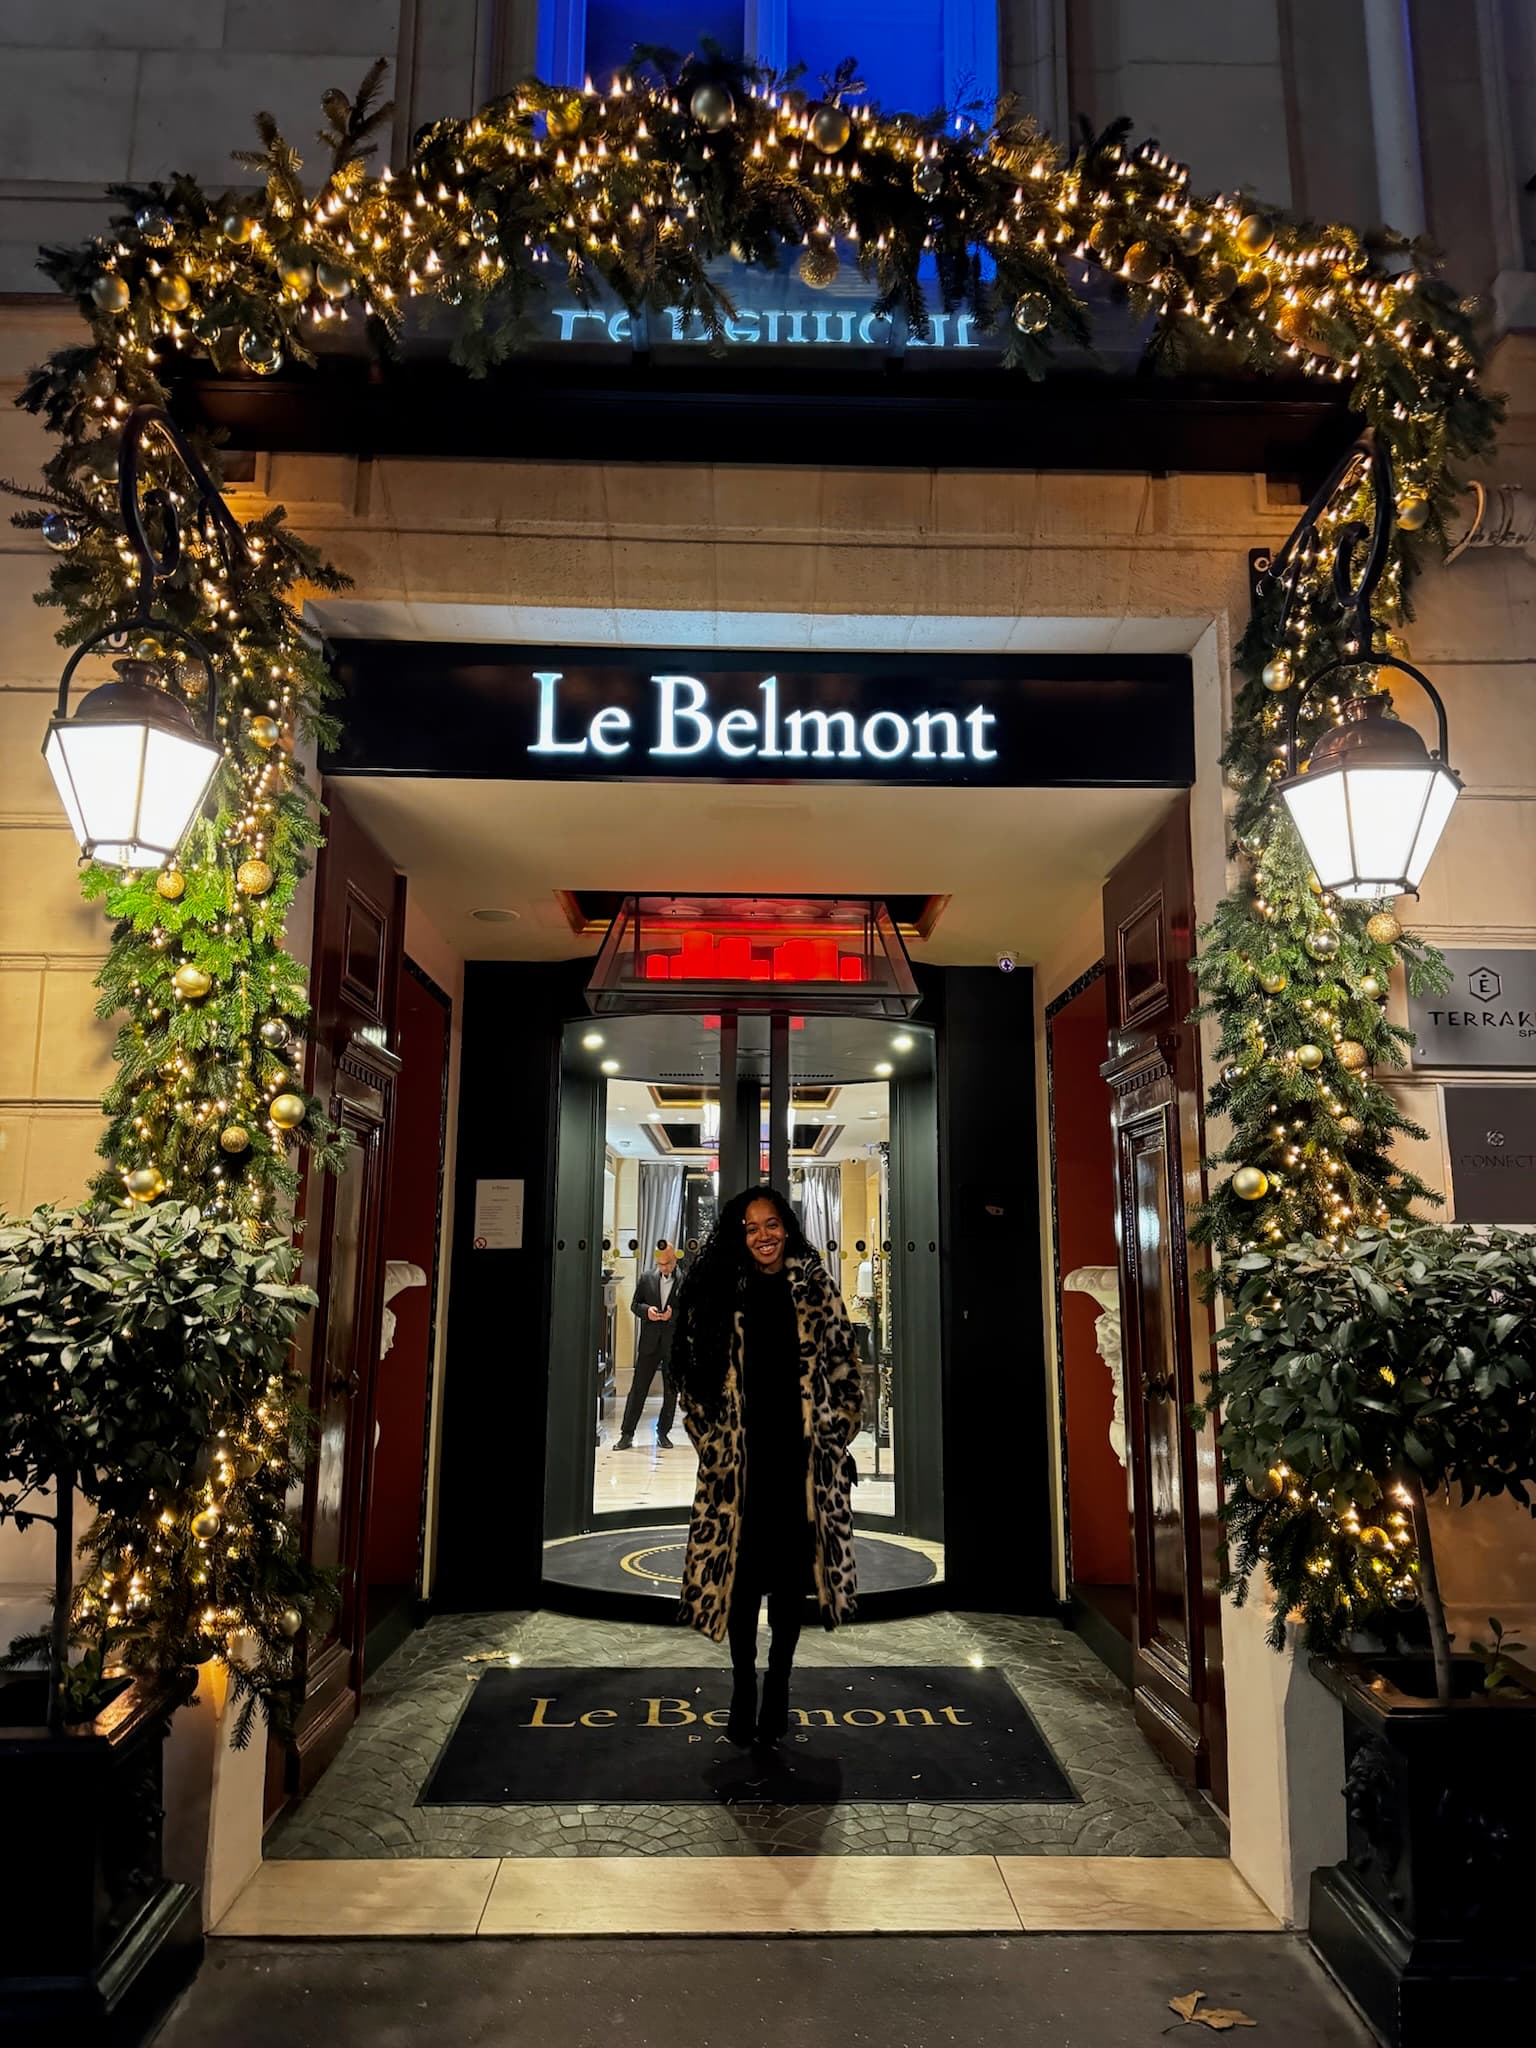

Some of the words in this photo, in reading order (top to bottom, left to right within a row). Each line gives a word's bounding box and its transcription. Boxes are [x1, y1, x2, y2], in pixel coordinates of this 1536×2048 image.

[527, 671, 631, 754] Le
[649, 675, 998, 760] Belmont
[1428, 1011, 1536, 1027] TERRAK
[519, 1698, 618, 1727] Le
[636, 1698, 973, 1727] Bemont
[688, 1734, 808, 1743] PAS
